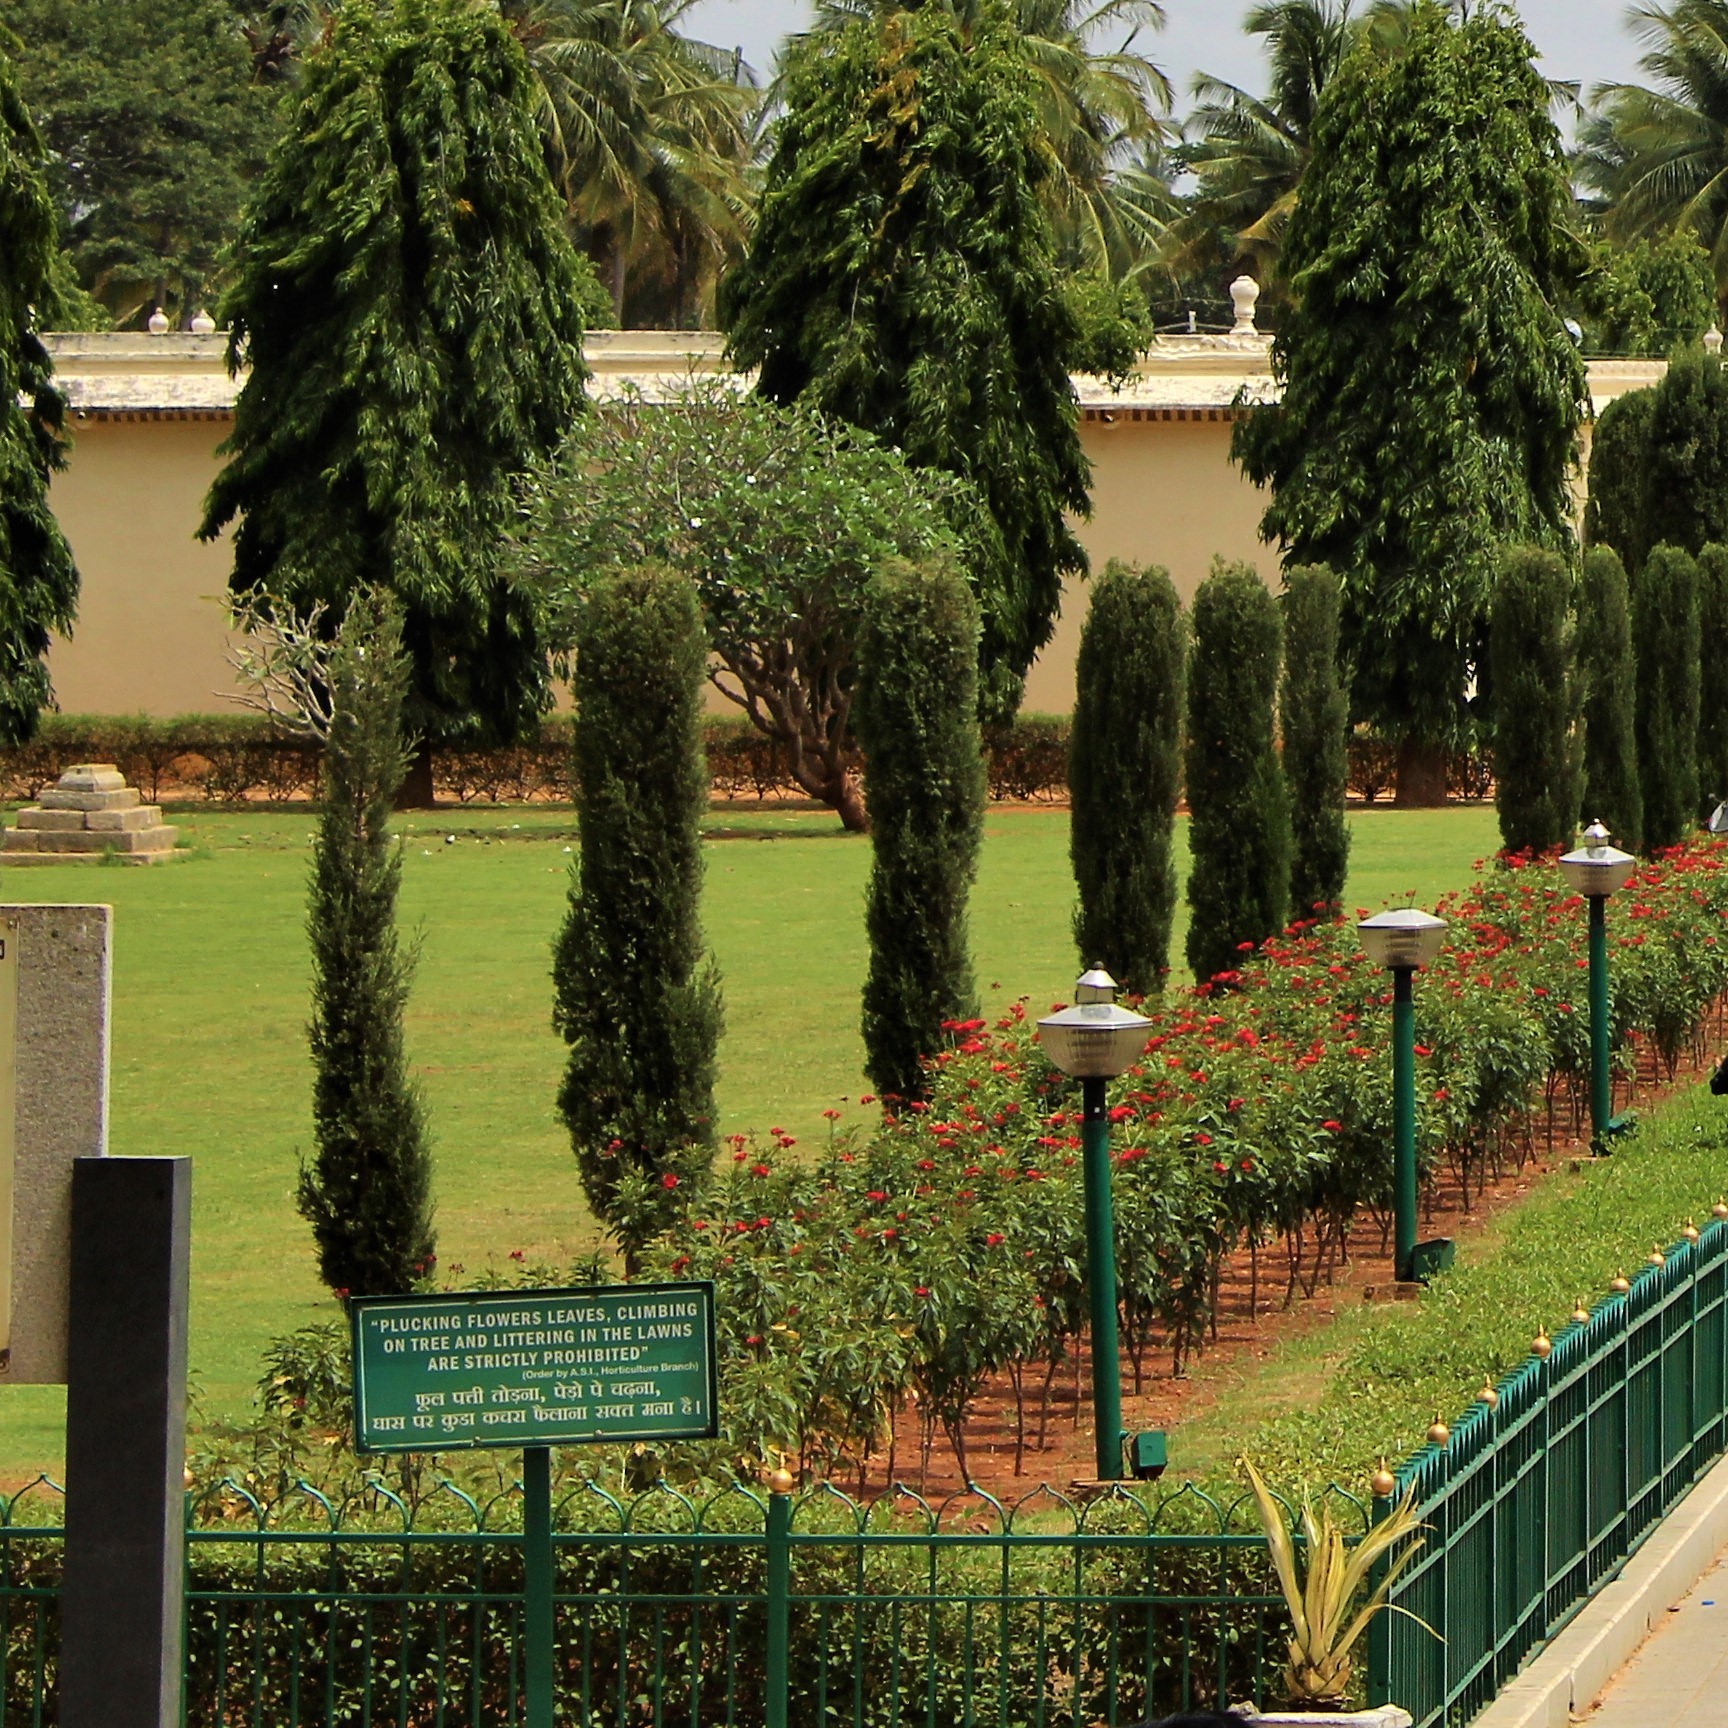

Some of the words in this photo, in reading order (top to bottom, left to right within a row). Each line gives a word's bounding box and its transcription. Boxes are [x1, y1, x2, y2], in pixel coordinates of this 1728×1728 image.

[468, 1311, 542, 1328] FLOWERS
[548, 1308, 611, 1324] LEAVES,
[617, 1303, 698, 1320] CLIMBING
[384, 1339, 405, 1353] ON
[411, 1337, 449, 1352] TREE
[455, 1335, 487, 1350] AND
[493, 1331, 574, 1347] LITTERING
[581, 1328, 597, 1342] IN
[603, 1326, 631, 1341] THE
[638, 1324, 692, 1339] LAWNS
[427, 1356, 459, 1371] ARE
[464, 1351, 539, 1370] STRICTLY
[522, 1370, 553, 1381] (Order
[556, 1369, 568, 1379] by
[601, 1365, 659, 1375] Horticulture
[661, 1362, 698, 1372] Branch)
[415, 1393, 445, 1412] फूल
[590, 1380, 603, 1397] पे
[372, 1417, 406, 1430] घास
[413, 1416, 433, 1429] पर
[533, 1405, 587, 1421] फैलाना
[642, 1402, 674, 1416] मना
